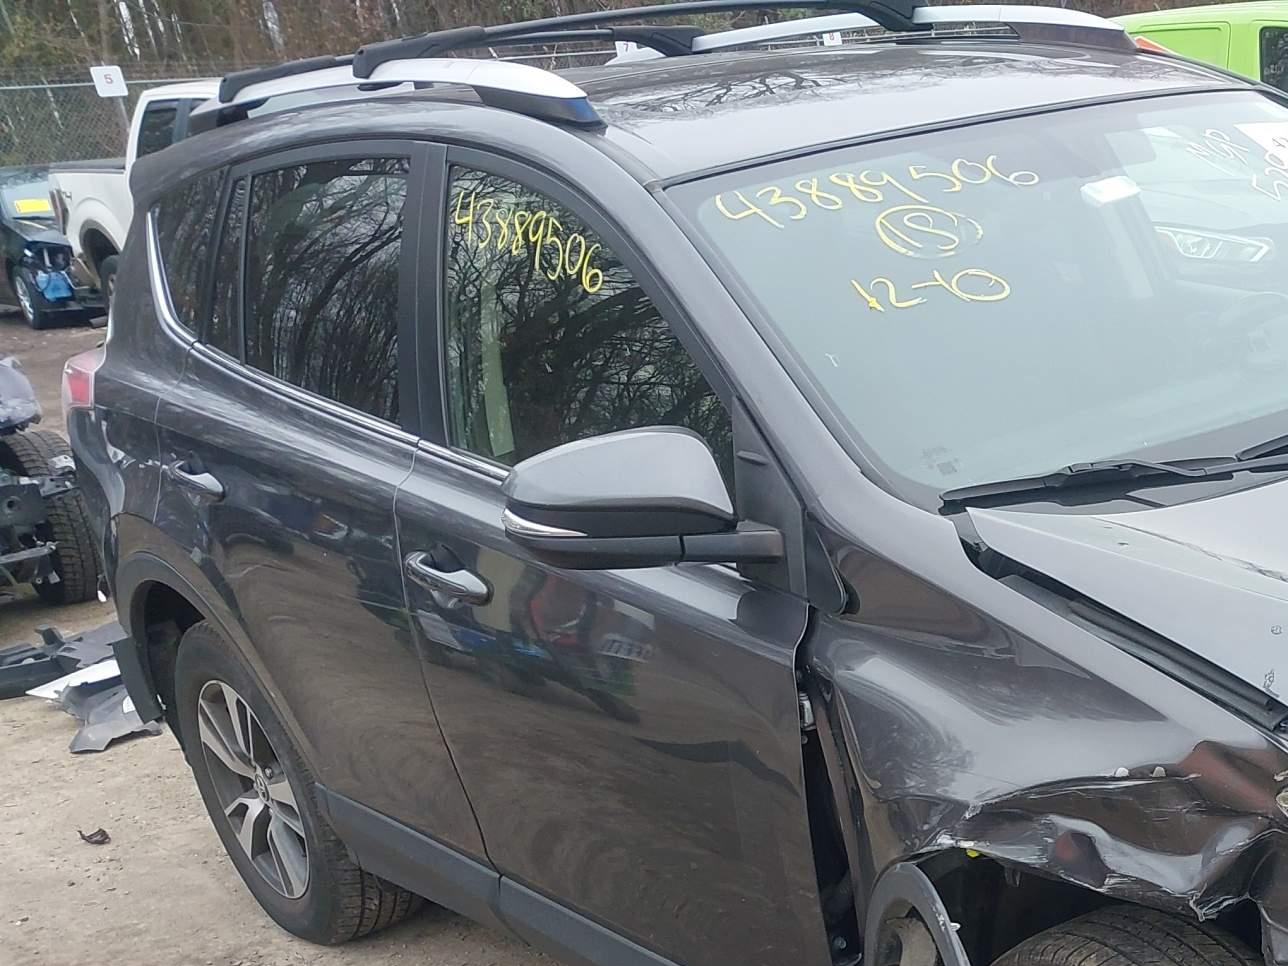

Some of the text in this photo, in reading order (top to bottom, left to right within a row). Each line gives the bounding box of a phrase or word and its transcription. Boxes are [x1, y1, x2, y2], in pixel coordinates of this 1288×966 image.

[104, 73, 113, 84] 5
[715, 154, 1040, 229] 43889506
[455, 191, 603, 294] 43889506
[851, 268, 1011, 312] 12-10
